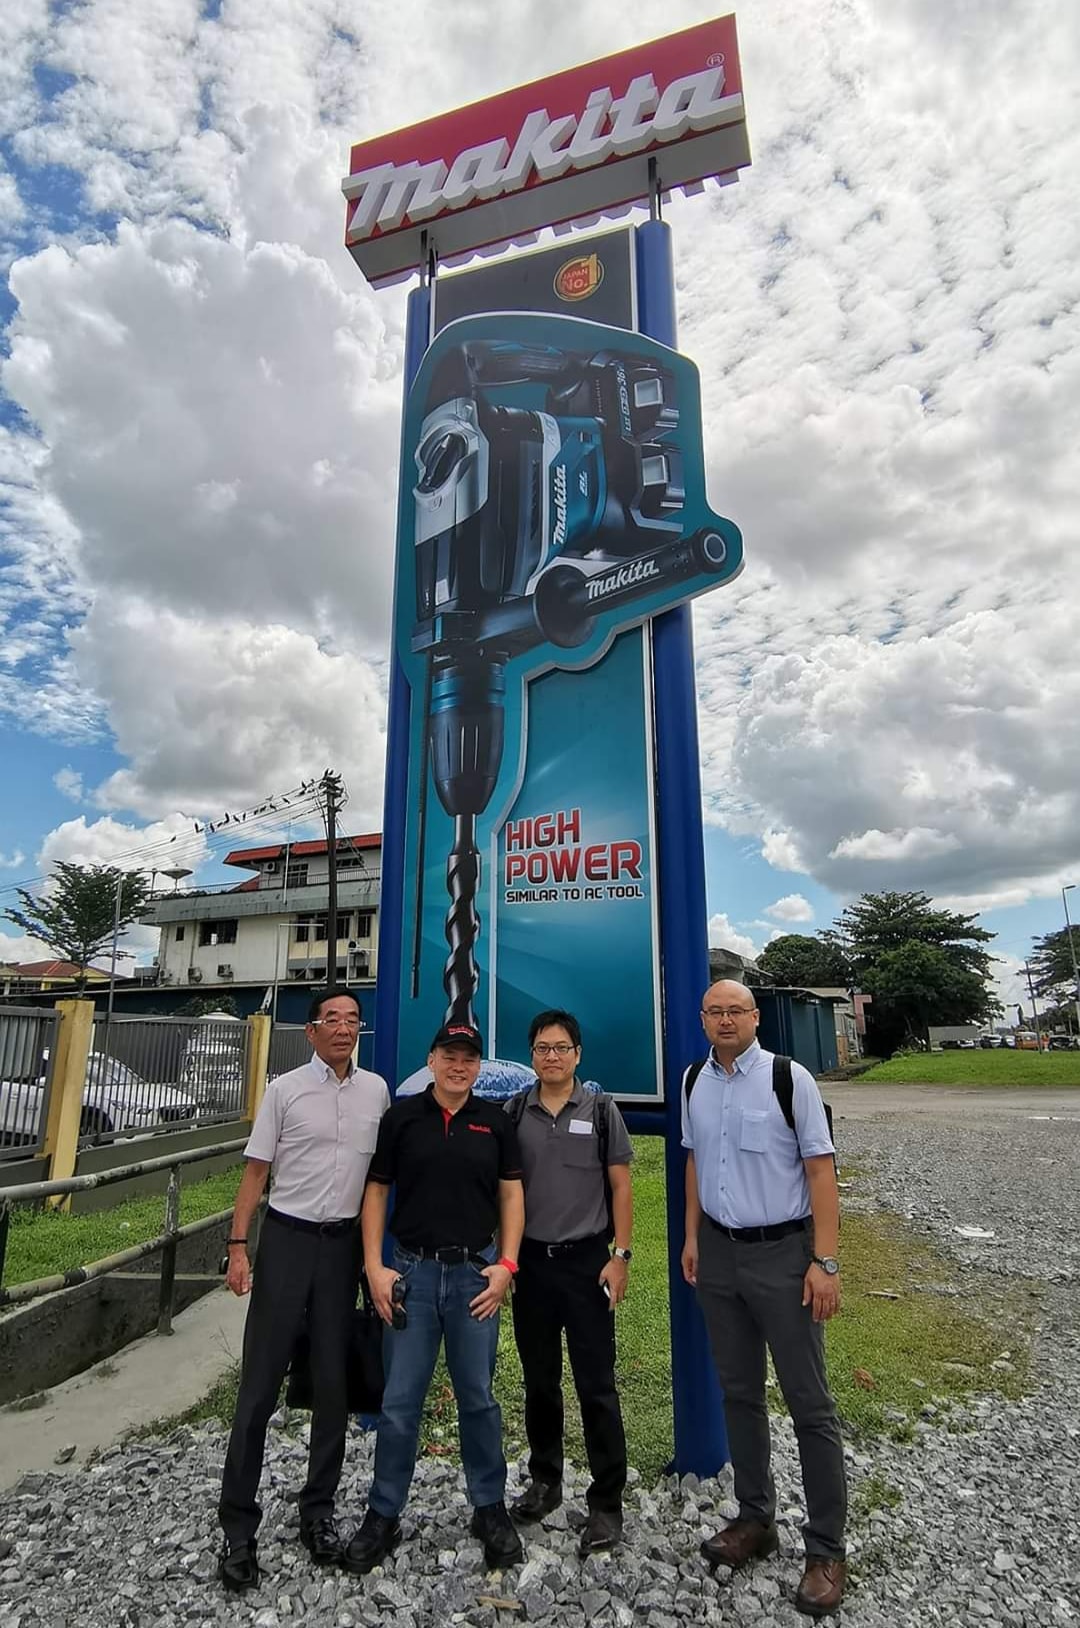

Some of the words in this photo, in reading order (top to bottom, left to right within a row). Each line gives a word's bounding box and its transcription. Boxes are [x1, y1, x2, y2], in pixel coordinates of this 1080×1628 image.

[506, 808, 581, 852] HIGH
[505, 840, 643, 886] POWER
[506, 889, 558, 903] SIMILAR
[562, 887, 580, 900] TO
[584, 886, 603, 900] AC
[606, 885, 643, 899] TOOL
